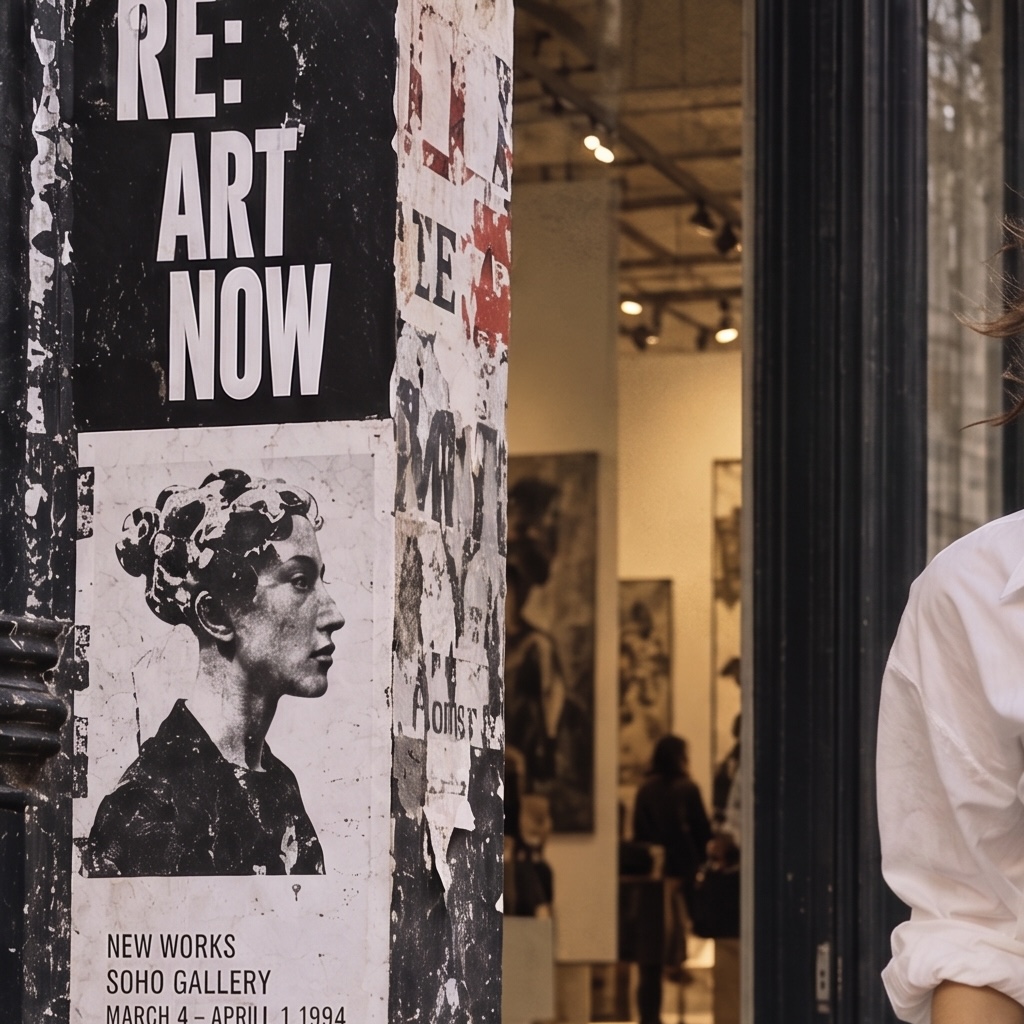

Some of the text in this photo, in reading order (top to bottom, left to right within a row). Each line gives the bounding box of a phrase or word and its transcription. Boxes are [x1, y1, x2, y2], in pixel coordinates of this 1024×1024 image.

[117, 0, 242, 121] RE:
[156, 127, 298, 262] ART
[168, 263, 331, 401] NOW
[106, 969, 272, 994] SOHO GALLERY
[107, 933, 236, 958] NEW WORKS
